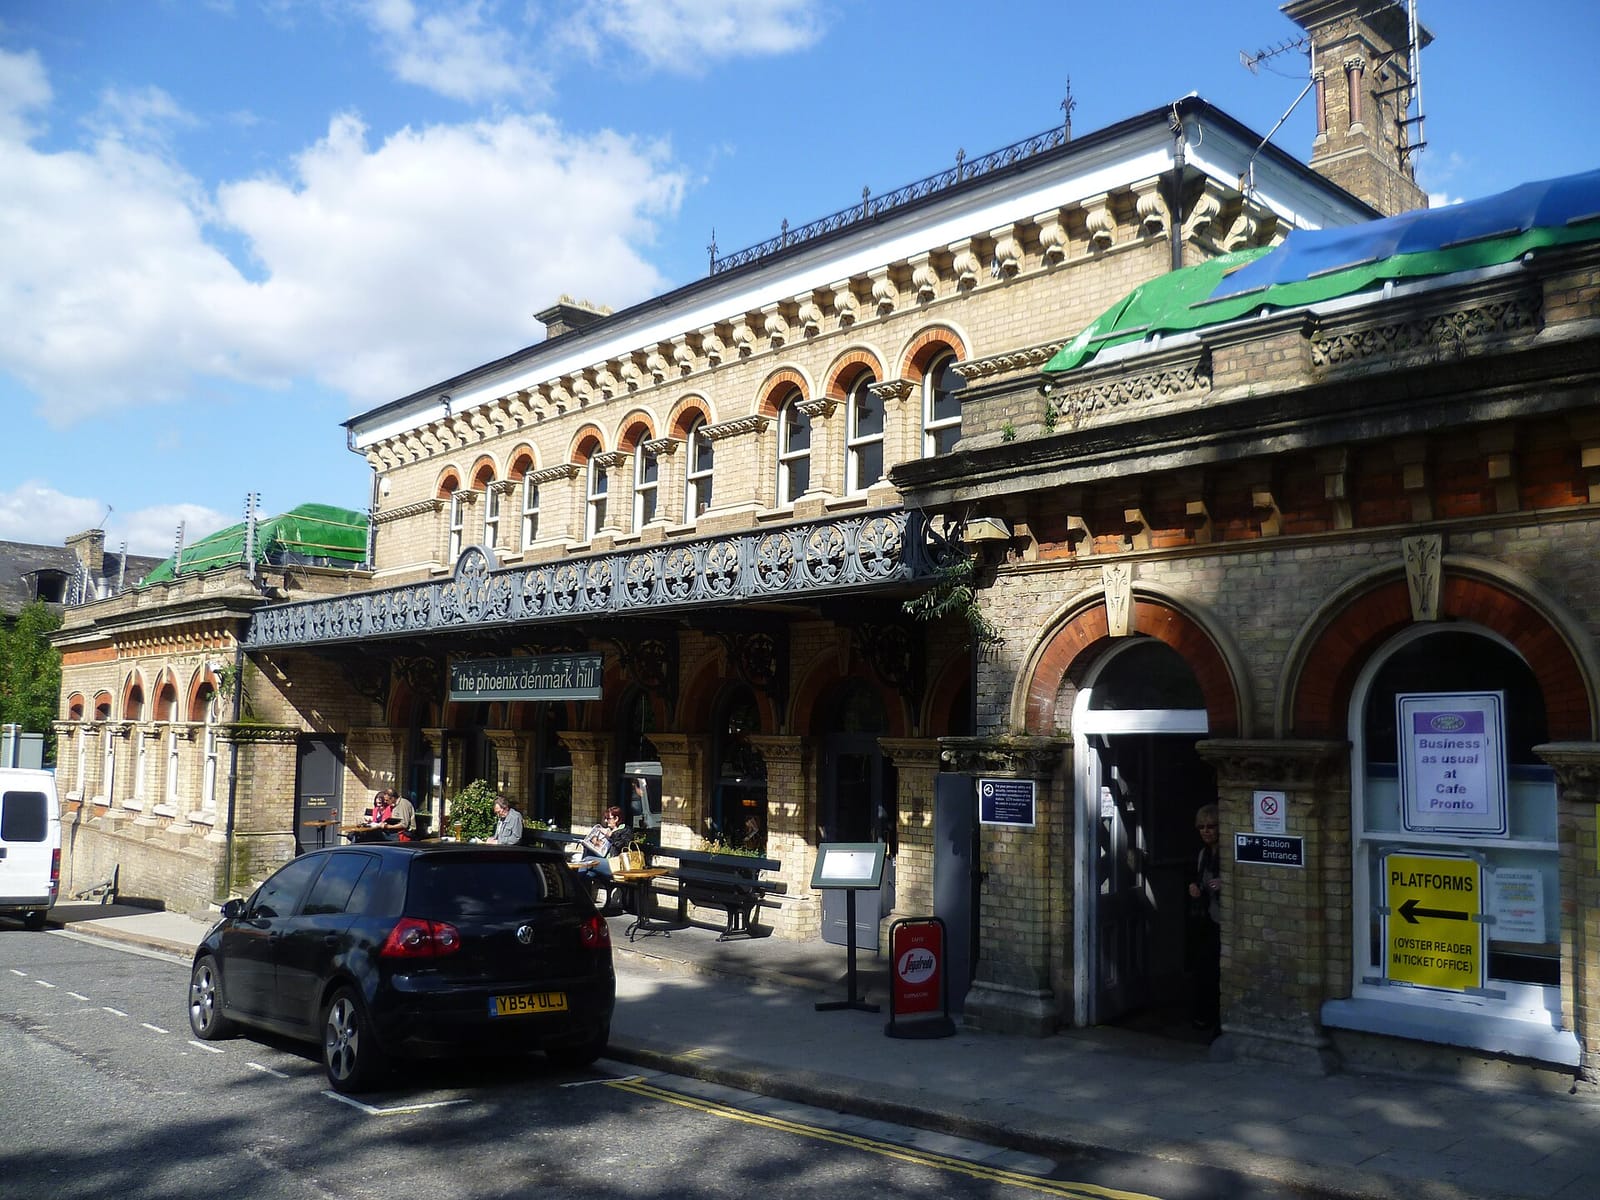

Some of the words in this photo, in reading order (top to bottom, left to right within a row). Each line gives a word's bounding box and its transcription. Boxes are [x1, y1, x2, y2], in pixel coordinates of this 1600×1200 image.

[459, 674, 474, 690] the
[477, 672, 518, 694] phoenix
[521, 669, 572, 689] denmark
[576, 667, 593, 687] hill
[1419, 738, 1480, 750] Business
[1421, 754, 1437, 764] as
[1441, 753, 1479, 764] usual
[1444, 769, 1456, 779] at
[1436, 783, 1466, 795] Cafe
[1430, 798, 1474, 810] Pronto
[1263, 839, 1290, 849] Station
[1263, 850, 1298, 861] Entrance
[1391, 871, 1473, 892] PLATFORMS
[1394, 937, 1433, 952] (OYSTER
[1434, 940, 1472, 955] READER
[1393, 953, 1401, 963] IN
[1403, 954, 1435, 968] TICKET
[1436, 957, 1473, 973] OFFICE)
[498, 996, 535, 1011] YB54
[539, 992, 564, 1007] ULJ
